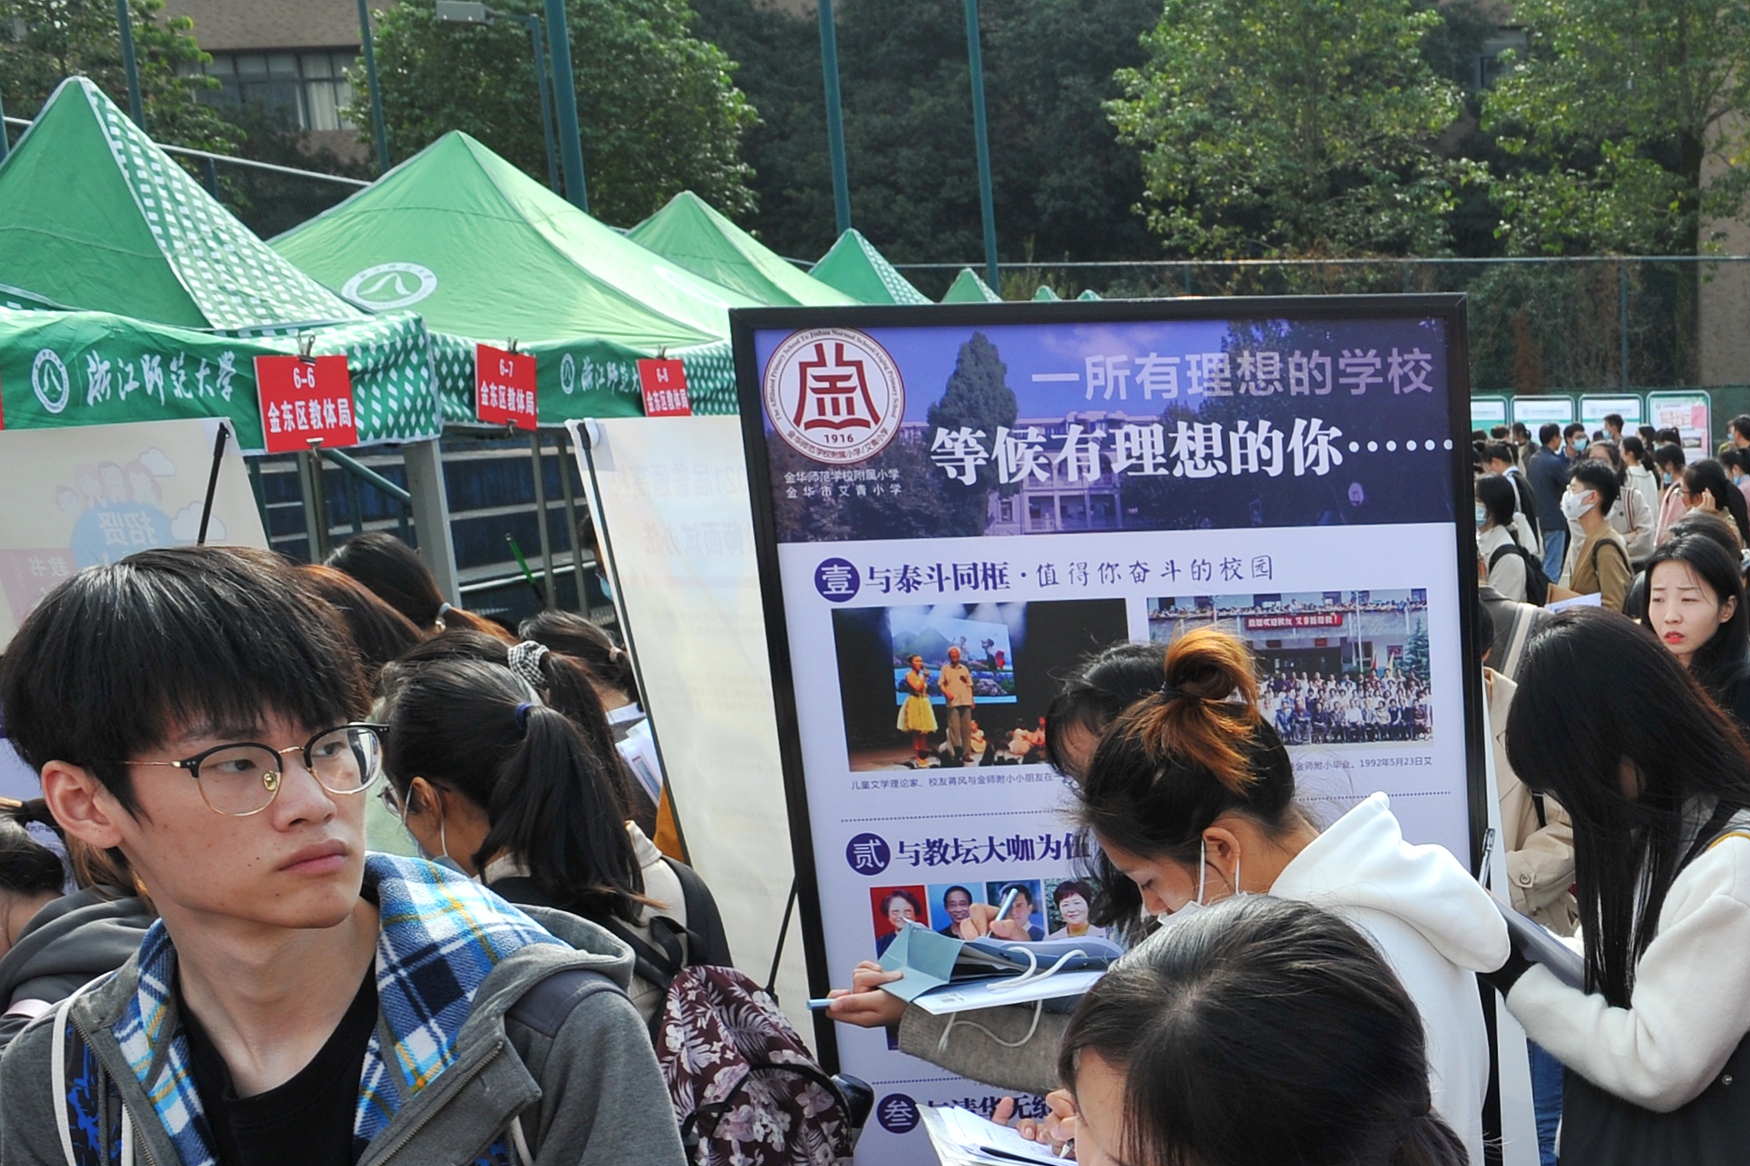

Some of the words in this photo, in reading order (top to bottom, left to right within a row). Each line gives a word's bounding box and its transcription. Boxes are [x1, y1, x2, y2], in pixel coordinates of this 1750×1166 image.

[87, 350, 237, 406] 浙江师范大学
[293, 367, 315, 389] 6-6
[500, 359, 514, 376] 6-7
[1031, 347, 1434, 401] 一所有理想的学校
[481, 381, 534, 416] 金东区教体局
[647, 391, 689, 412] 金东区教体局
[267, 398, 352, 433] 金东区教体局
[824, 434, 854, 443] 1916
[784, 469, 900, 483] 金华师范学校附属小学
[786, 484, 902, 498] 金华市艾青小学
[853, 839, 885, 869] 贰
